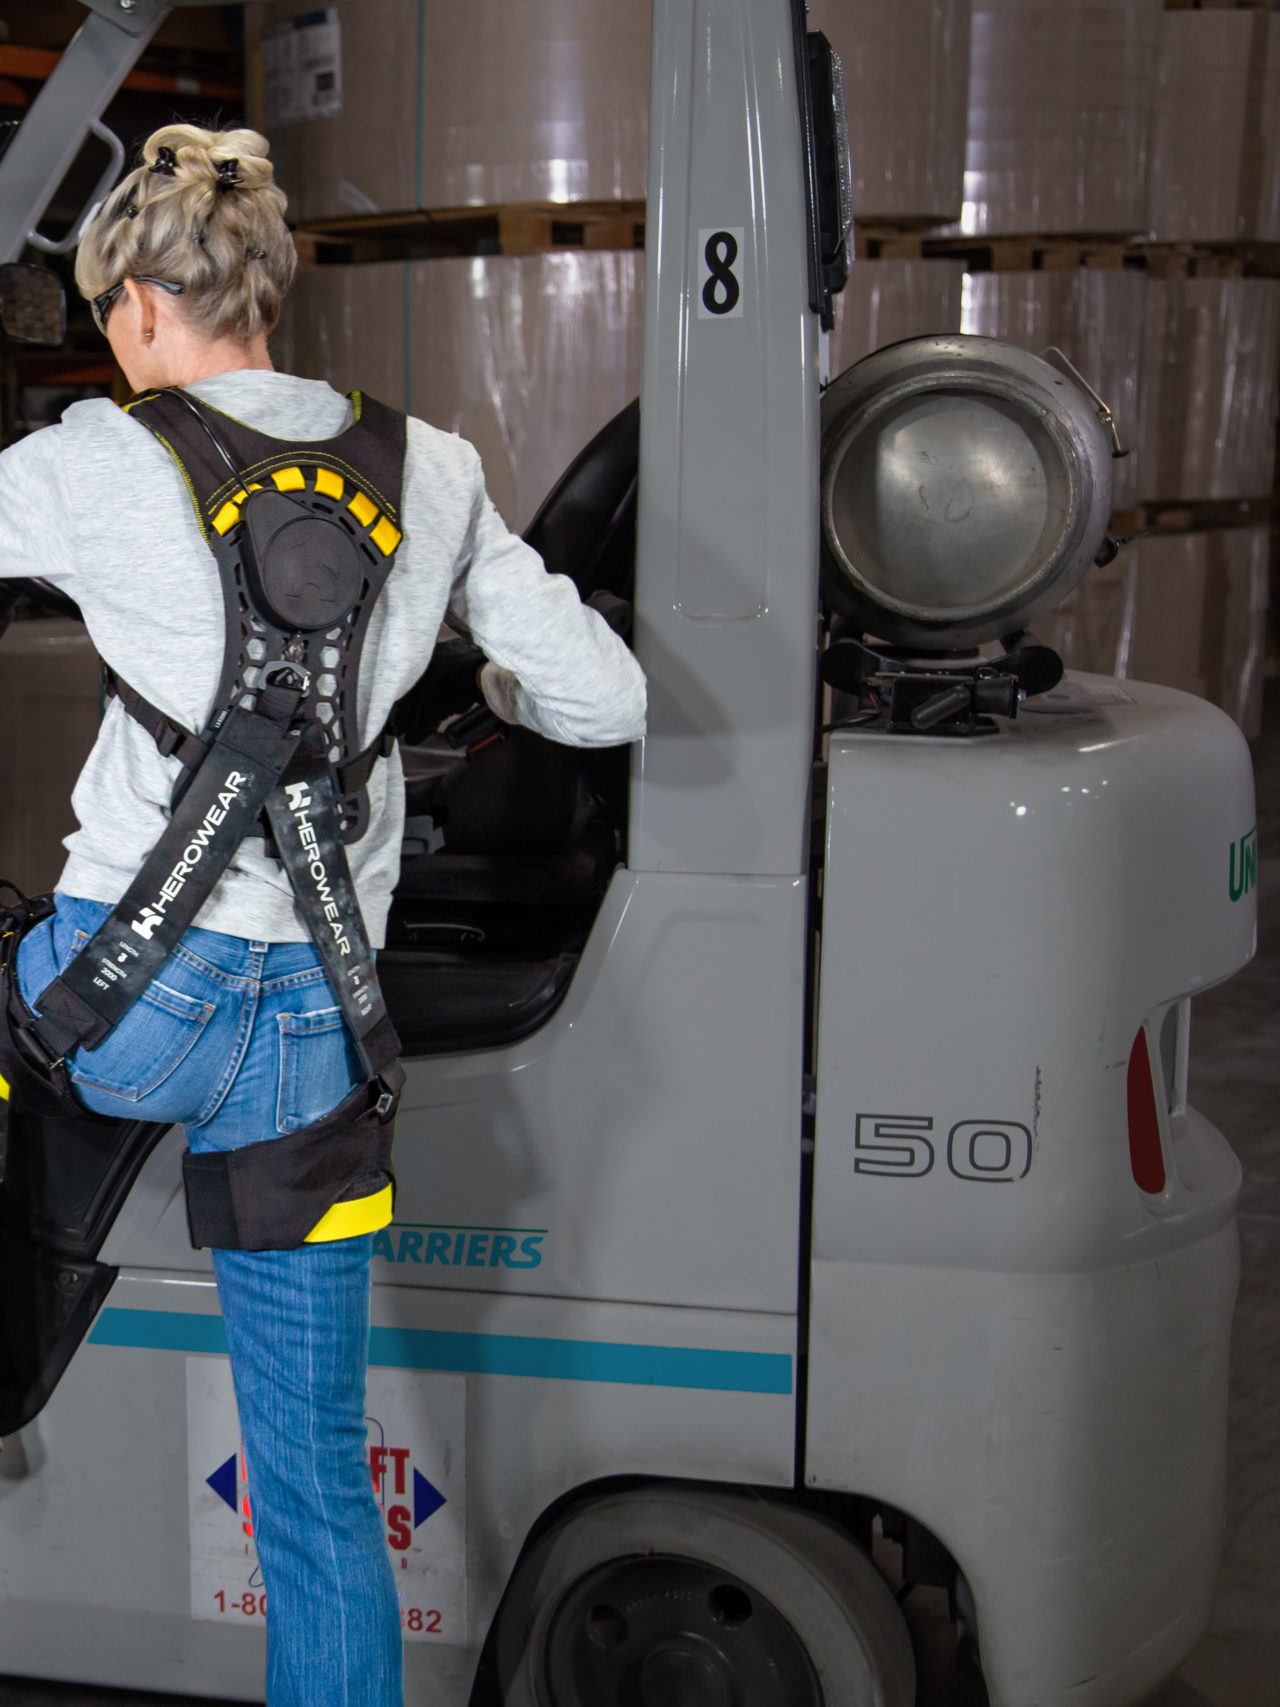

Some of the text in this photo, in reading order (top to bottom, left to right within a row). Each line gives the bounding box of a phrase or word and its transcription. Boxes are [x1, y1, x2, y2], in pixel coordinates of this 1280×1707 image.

[702, 231, 740, 315] 8
[152, 771, 247, 914] HEROWEAR
[294, 810, 351, 956] HEROWEAR
[92, 976, 111, 990] LEFT
[854, 1113, 1033, 1183] 50
[373, 1229, 544, 1269] ARRIERS
